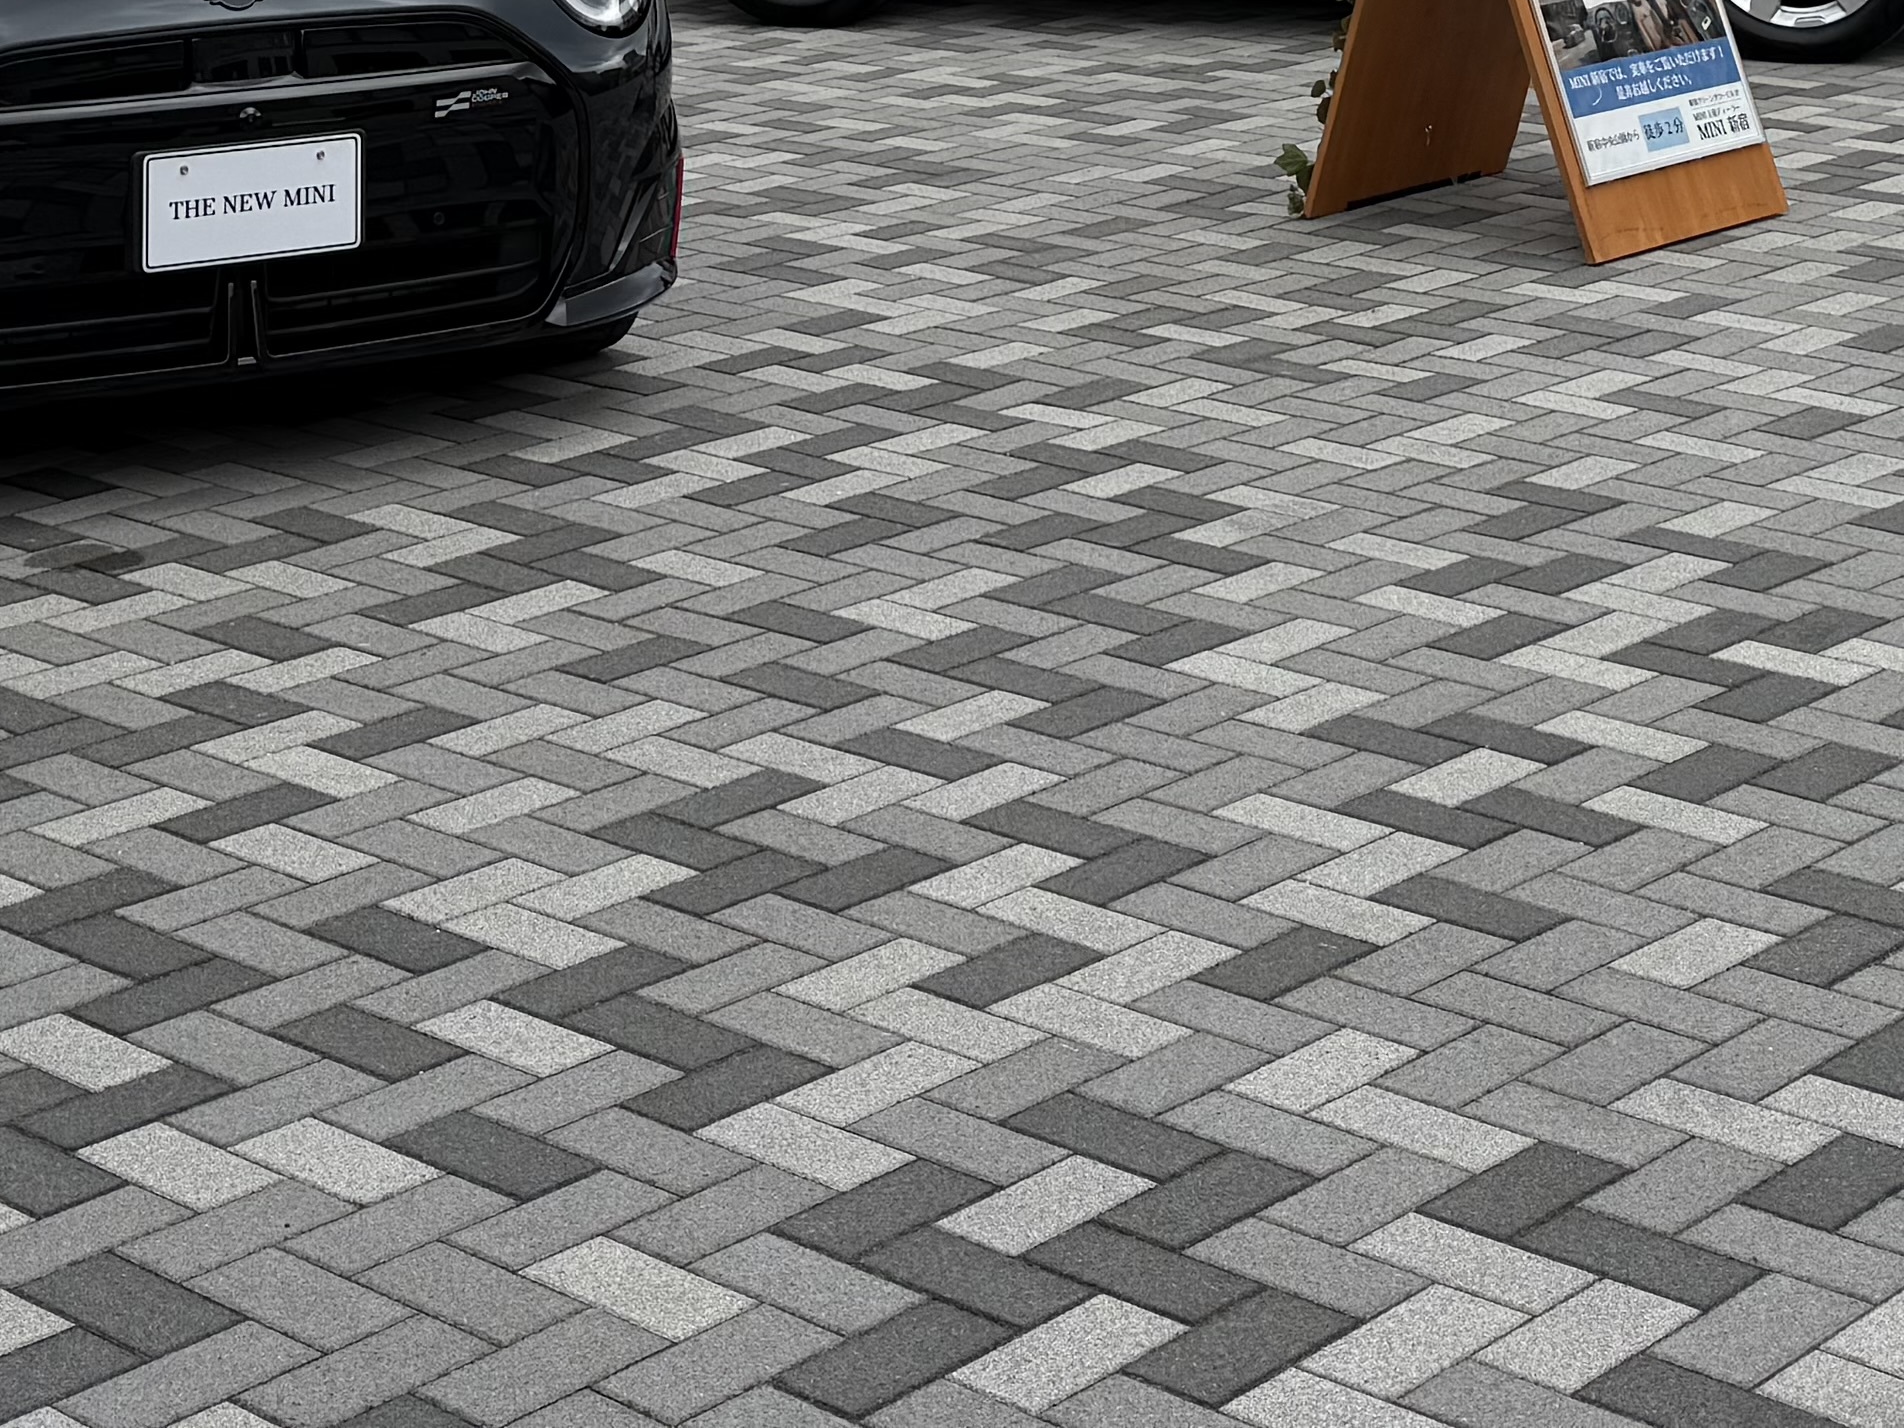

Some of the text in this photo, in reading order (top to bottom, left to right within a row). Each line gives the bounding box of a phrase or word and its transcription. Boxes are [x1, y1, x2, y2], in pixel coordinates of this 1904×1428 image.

[1696, 119, 1728, 141] MINI
[169, 184, 336, 220] THE NEW MINI
